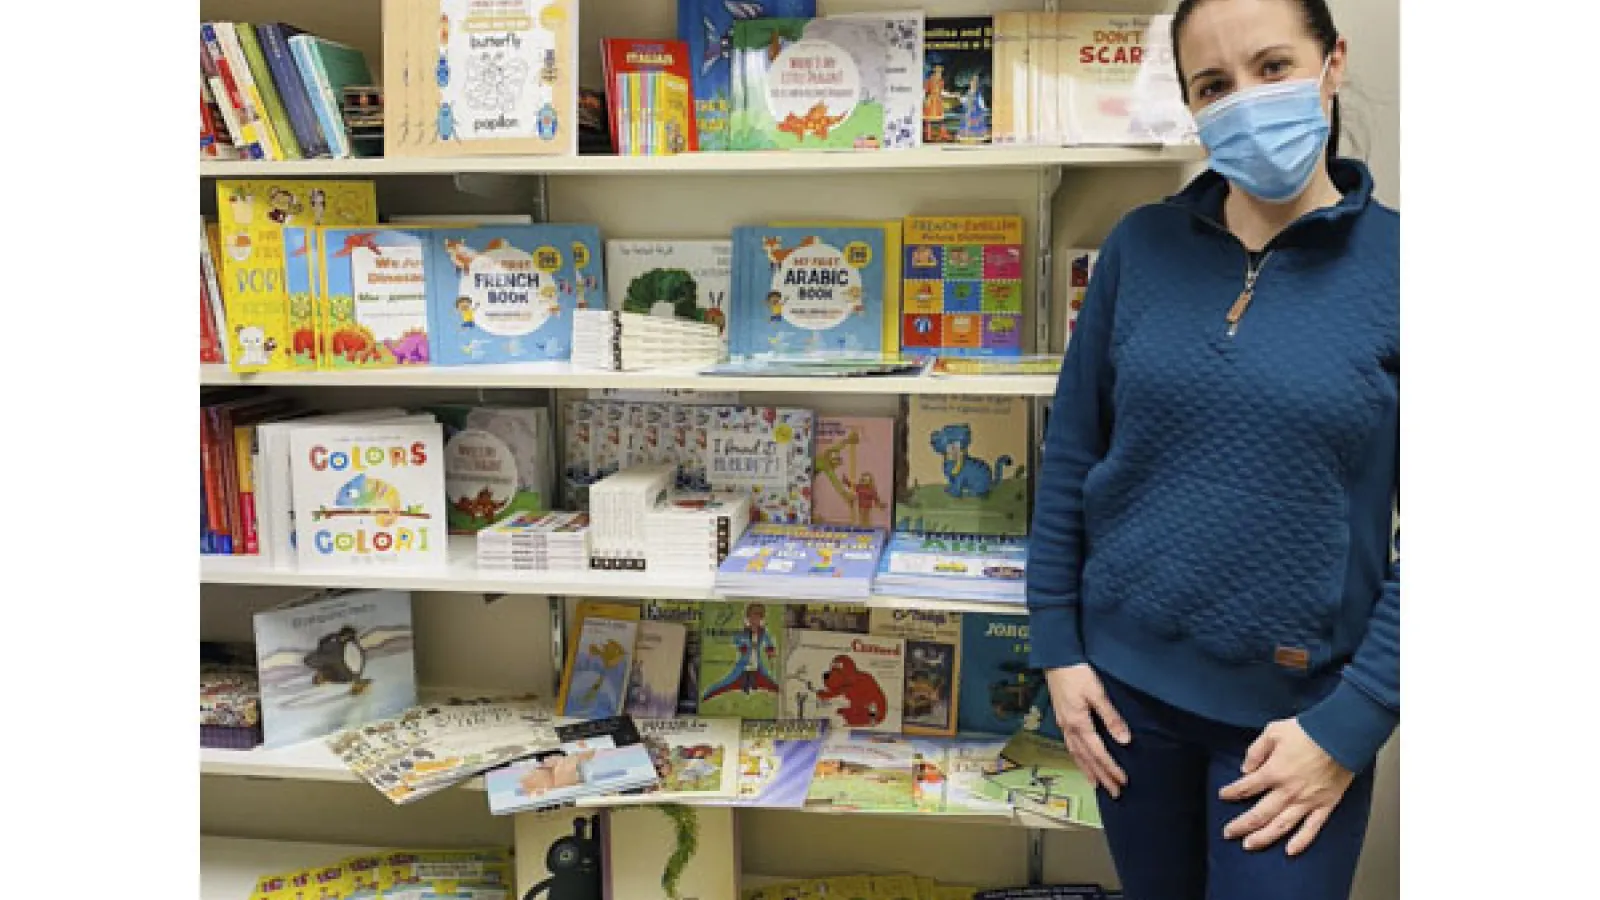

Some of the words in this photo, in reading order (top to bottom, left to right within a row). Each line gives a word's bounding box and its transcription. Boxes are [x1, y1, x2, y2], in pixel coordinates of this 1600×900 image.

[470, 33, 522, 49] butterfly
[1093, 30, 1144, 45] DON'T
[473, 114, 519, 132] papillon
[474, 272, 539, 288] FRENCH
[784, 268, 848, 285] ARABIC
[487, 290, 529, 304] BOOK
[798, 287, 832, 301] BOOK
[725, 437, 761, 456] found
[309, 441, 427, 471] COLORS
[314, 527, 429, 555] COLORI
